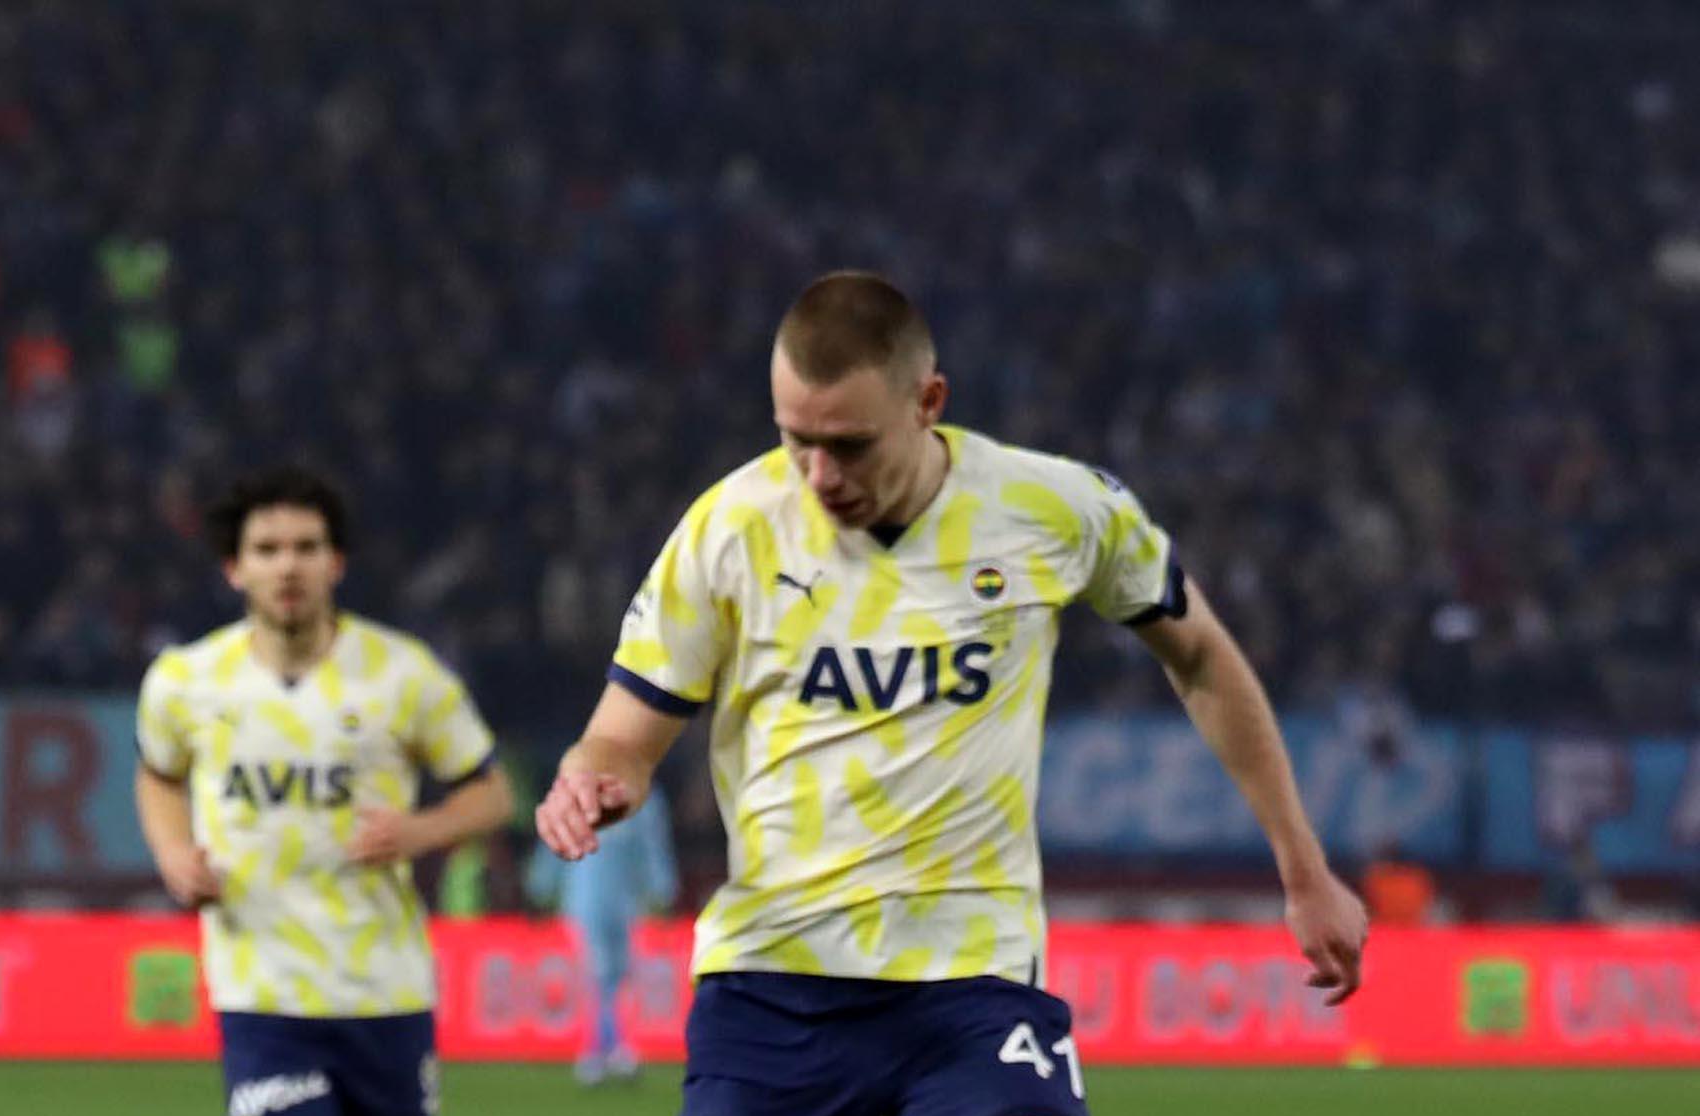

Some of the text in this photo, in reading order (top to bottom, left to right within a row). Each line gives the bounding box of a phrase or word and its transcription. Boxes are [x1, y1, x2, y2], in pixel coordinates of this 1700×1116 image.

[799, 641, 993, 713] AVIS
[222, 762, 353, 808] AVIS
[998, 1022, 1085, 1101] 41
